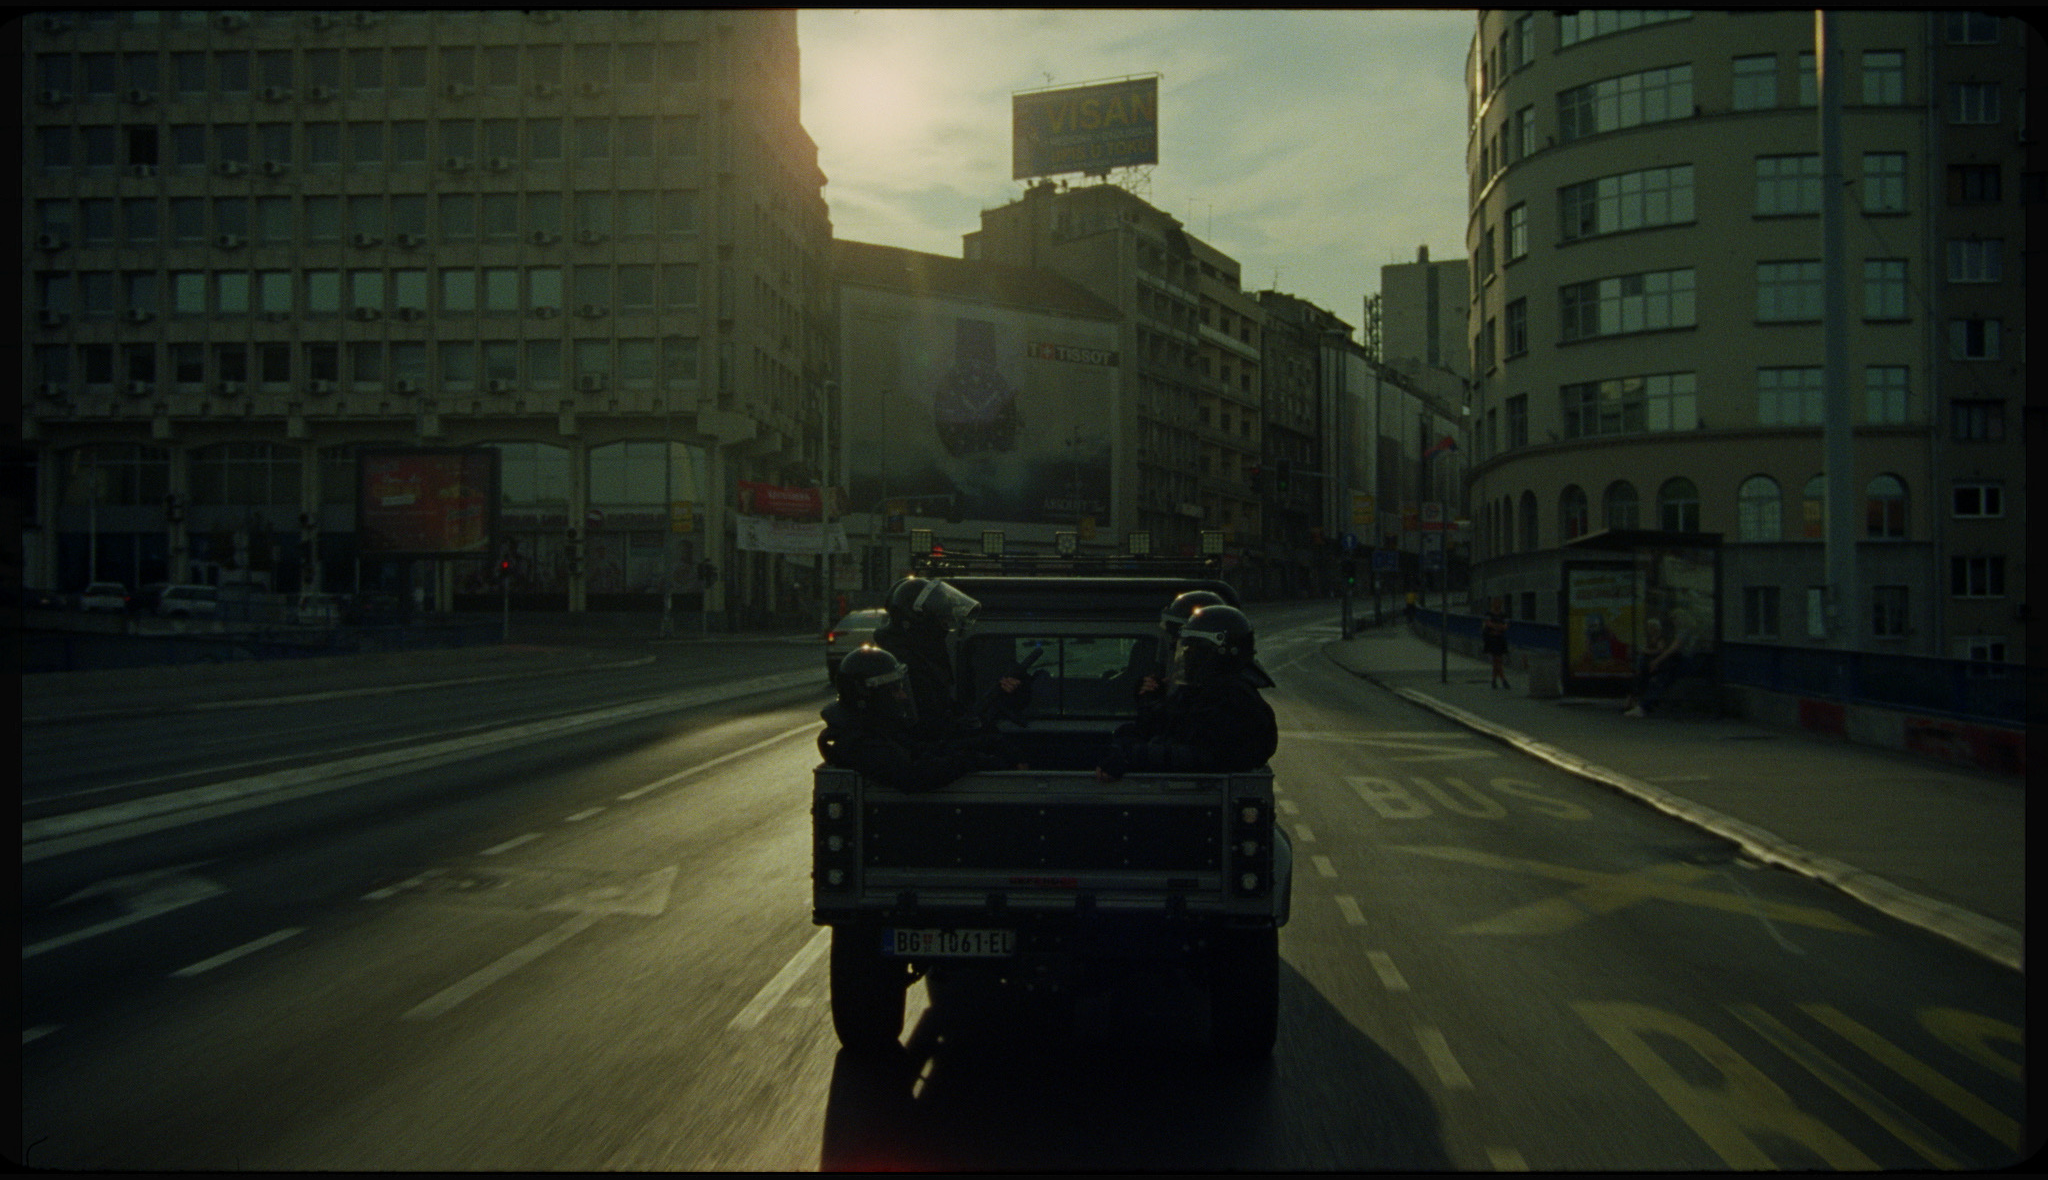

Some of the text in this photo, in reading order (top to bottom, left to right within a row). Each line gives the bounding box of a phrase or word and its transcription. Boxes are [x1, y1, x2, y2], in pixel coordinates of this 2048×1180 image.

[1045, 92, 1155, 134] VISAN
[1056, 347, 1110, 366] TISSOT
[1345, 776, 1593, 820] BUS
[897, 931, 919, 952] BG
